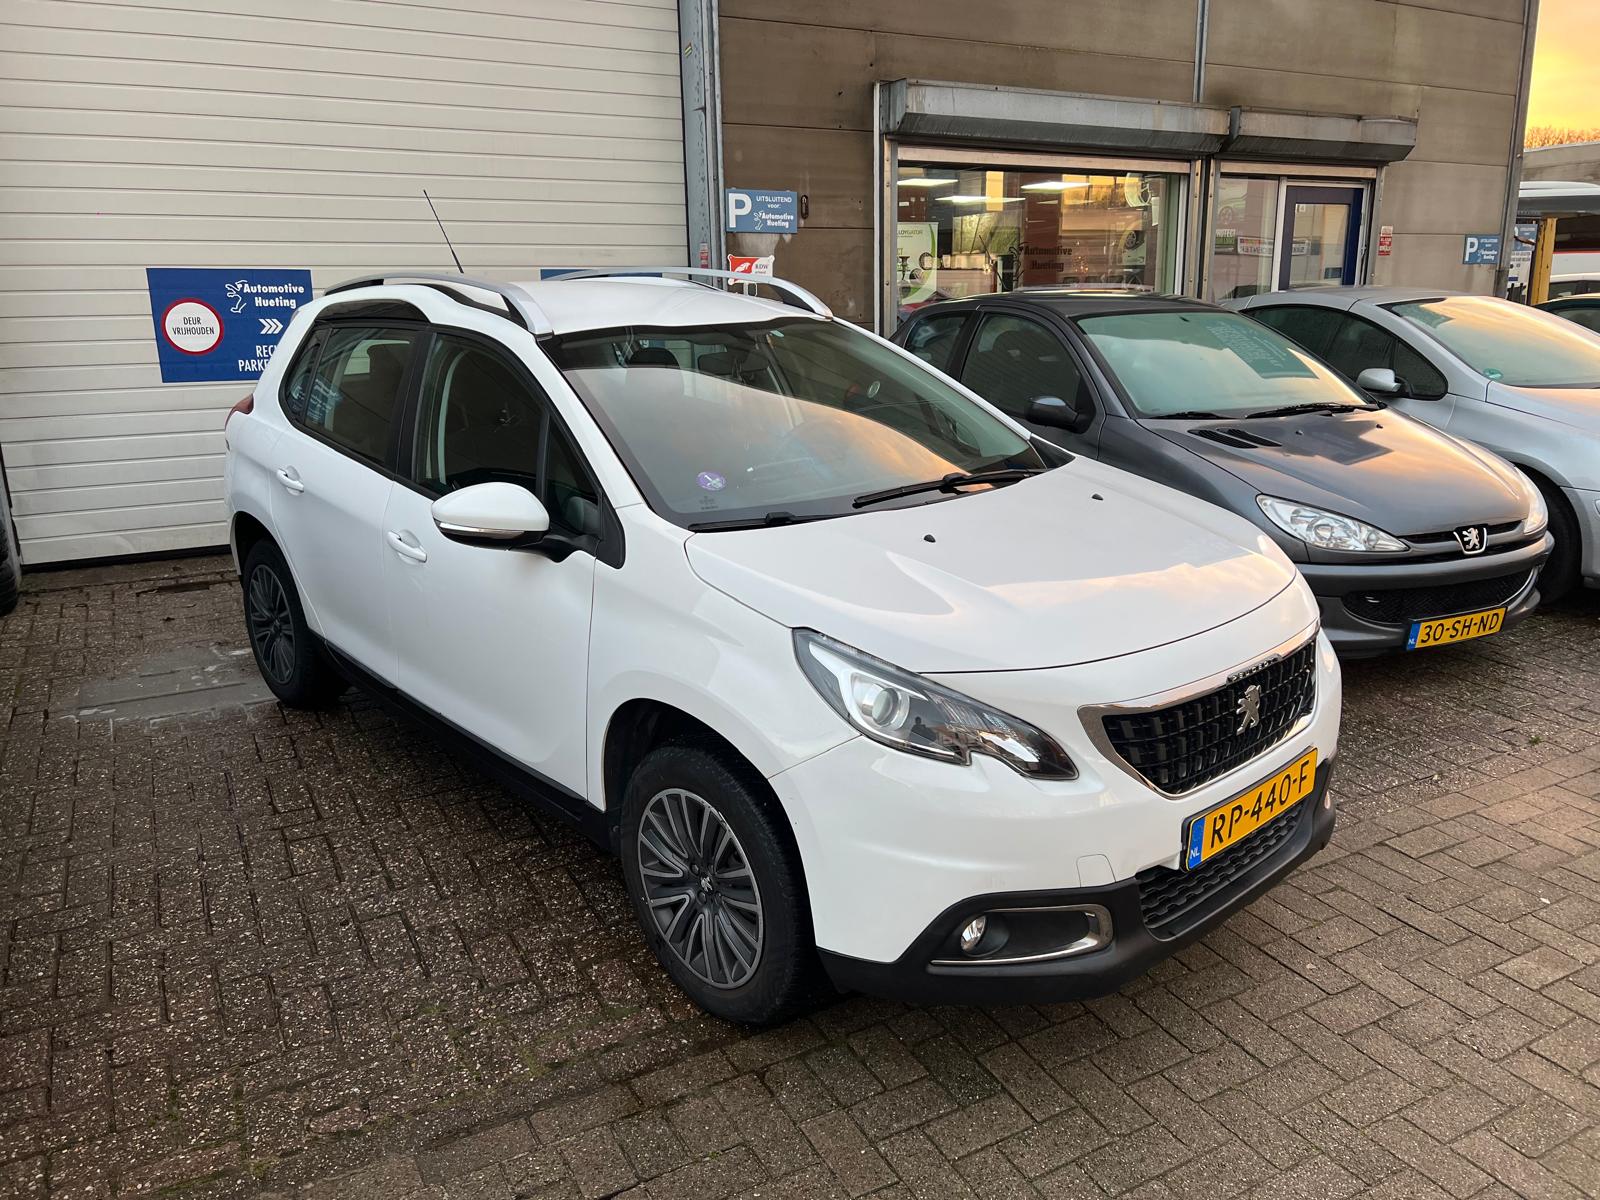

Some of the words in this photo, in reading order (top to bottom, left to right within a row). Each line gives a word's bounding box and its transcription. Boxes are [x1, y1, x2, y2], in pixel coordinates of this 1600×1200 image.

[756, 195, 792, 203] UITSLUITEND
[728, 192, 752, 228] P
[761, 212, 794, 220] Automotive
[1024, 245, 1073, 256] Automotive
[1465, 237, 1478, 261] P
[243, 283, 305, 294] Automotive
[254, 296, 297, 309] Hueting
[183, 316, 202, 326] DEUR
[172, 326, 215, 336] VRIJHOUDEN
[256, 344, 277, 358] REC
[1421, 612, 1500, 643] 30-SH-ND
[1190, 846, 1200, 860] NL
[1211, 759, 1310, 848] RP-440-F
